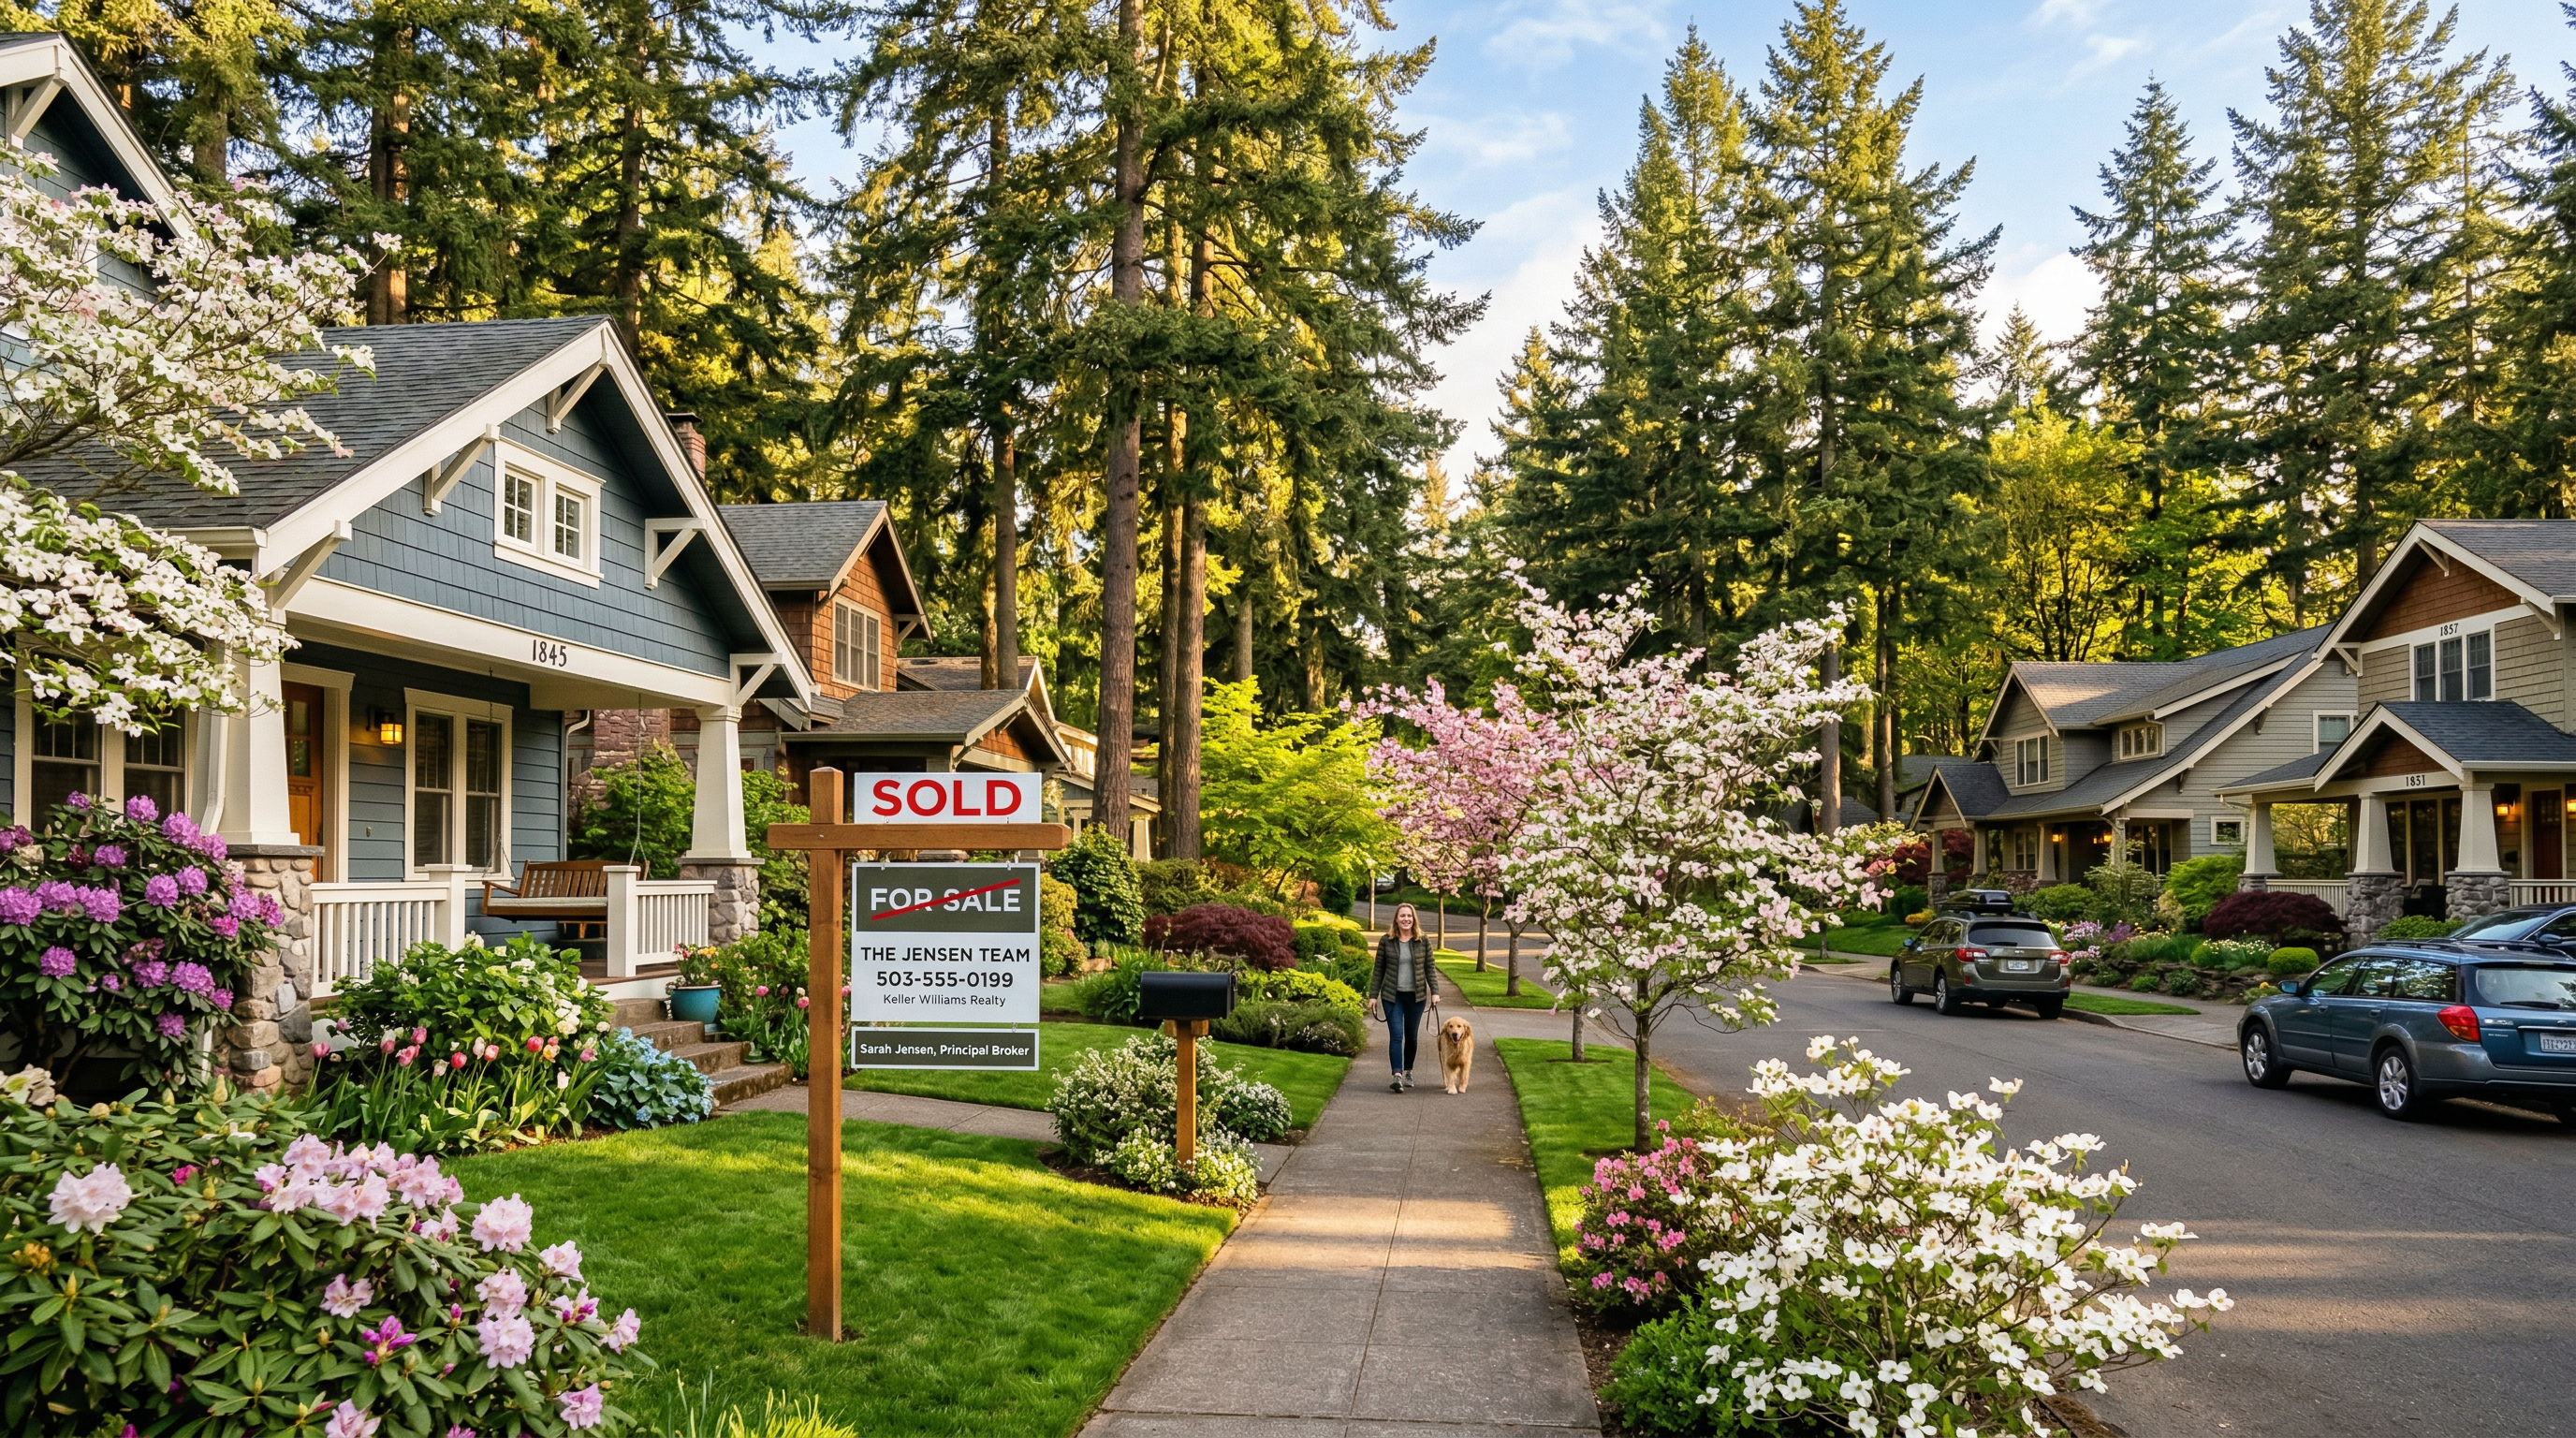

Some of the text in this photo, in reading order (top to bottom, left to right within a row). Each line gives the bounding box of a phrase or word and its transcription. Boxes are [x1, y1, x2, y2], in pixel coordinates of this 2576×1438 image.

[2439, 623, 2459, 637] 1857
[532, 638, 567, 668] 1845
[871, 779, 1022, 817] SOLD
[871, 888, 1021, 912] FOR SALE
[860, 946, 1030, 962] THE JENSEN TEAM
[876, 971, 1014, 988] 503-555-0199
[884, 994, 1006, 1007] Keller Williams Realty
[859, 1043, 1030, 1058] Sarah Jensen, Principal Broker
